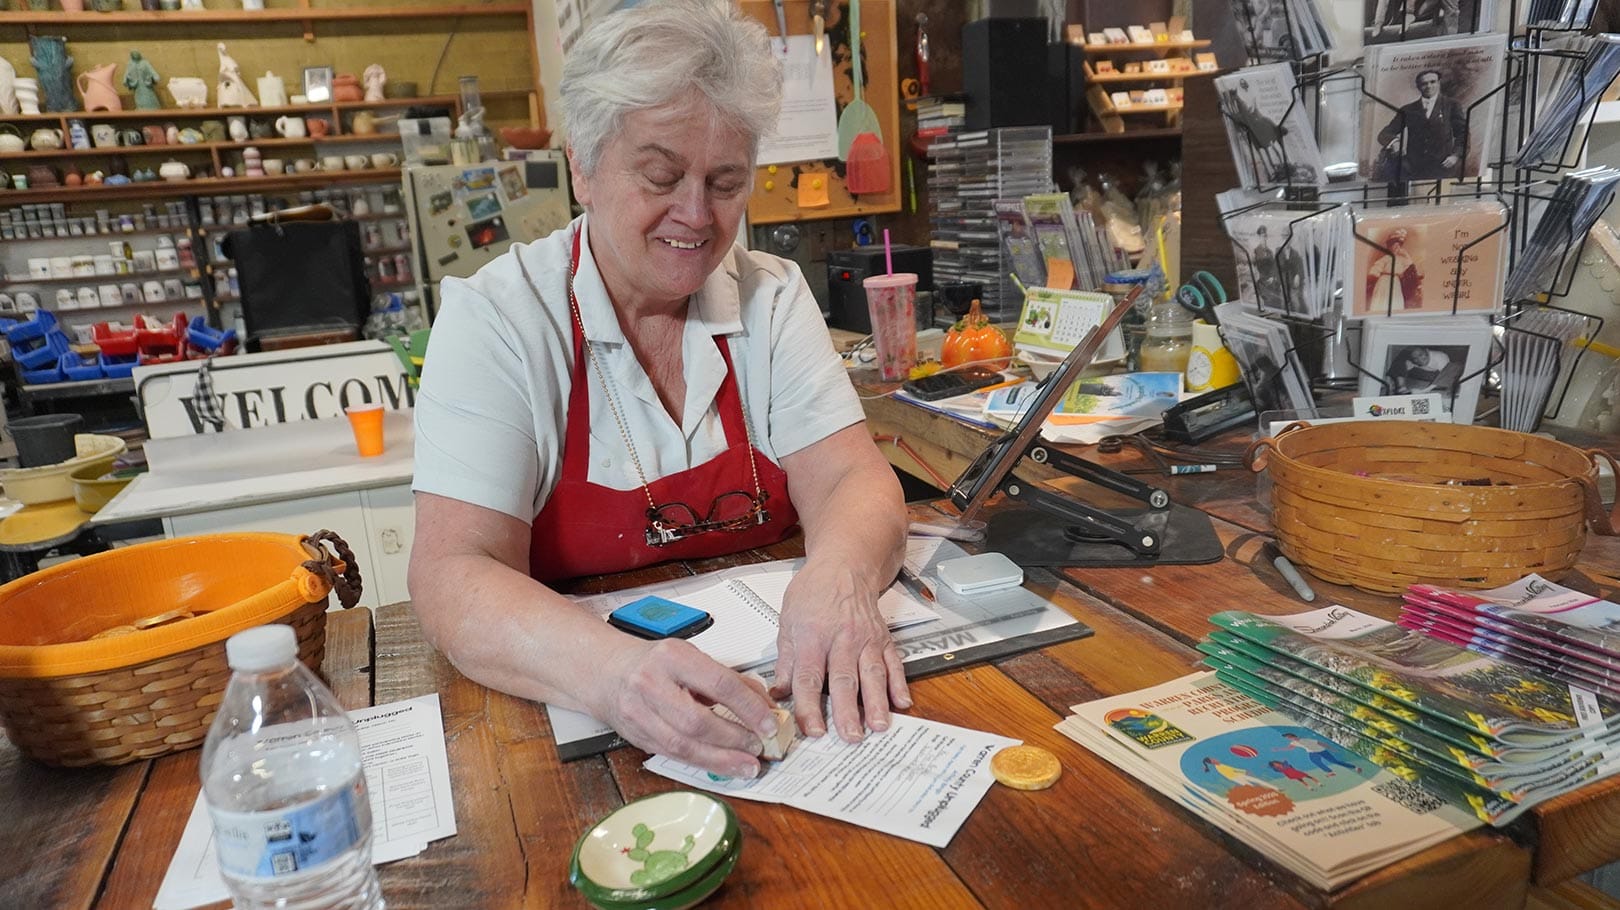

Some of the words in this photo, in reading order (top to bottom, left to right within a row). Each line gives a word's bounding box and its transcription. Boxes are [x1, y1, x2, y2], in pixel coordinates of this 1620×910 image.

[178, 372, 417, 433] WELCOM
[897, 631, 978, 658] MARC
[1139, 693, 1191, 709] WARREN
[1190, 683, 1227, 697] COUNT
[1182, 693, 1223, 708] PARKS
[1222, 688, 1240, 696] AN
[1212, 700, 1262, 718] PROGRA
[1136, 728, 1182, 742] WARREN
[1144, 732, 1185, 746] COUNTY
[969, 743, 995, 768] Warren
[949, 768, 976, 793] County
[920, 787, 957, 829] Unplugged
[1276, 816, 1301, 826] Check
